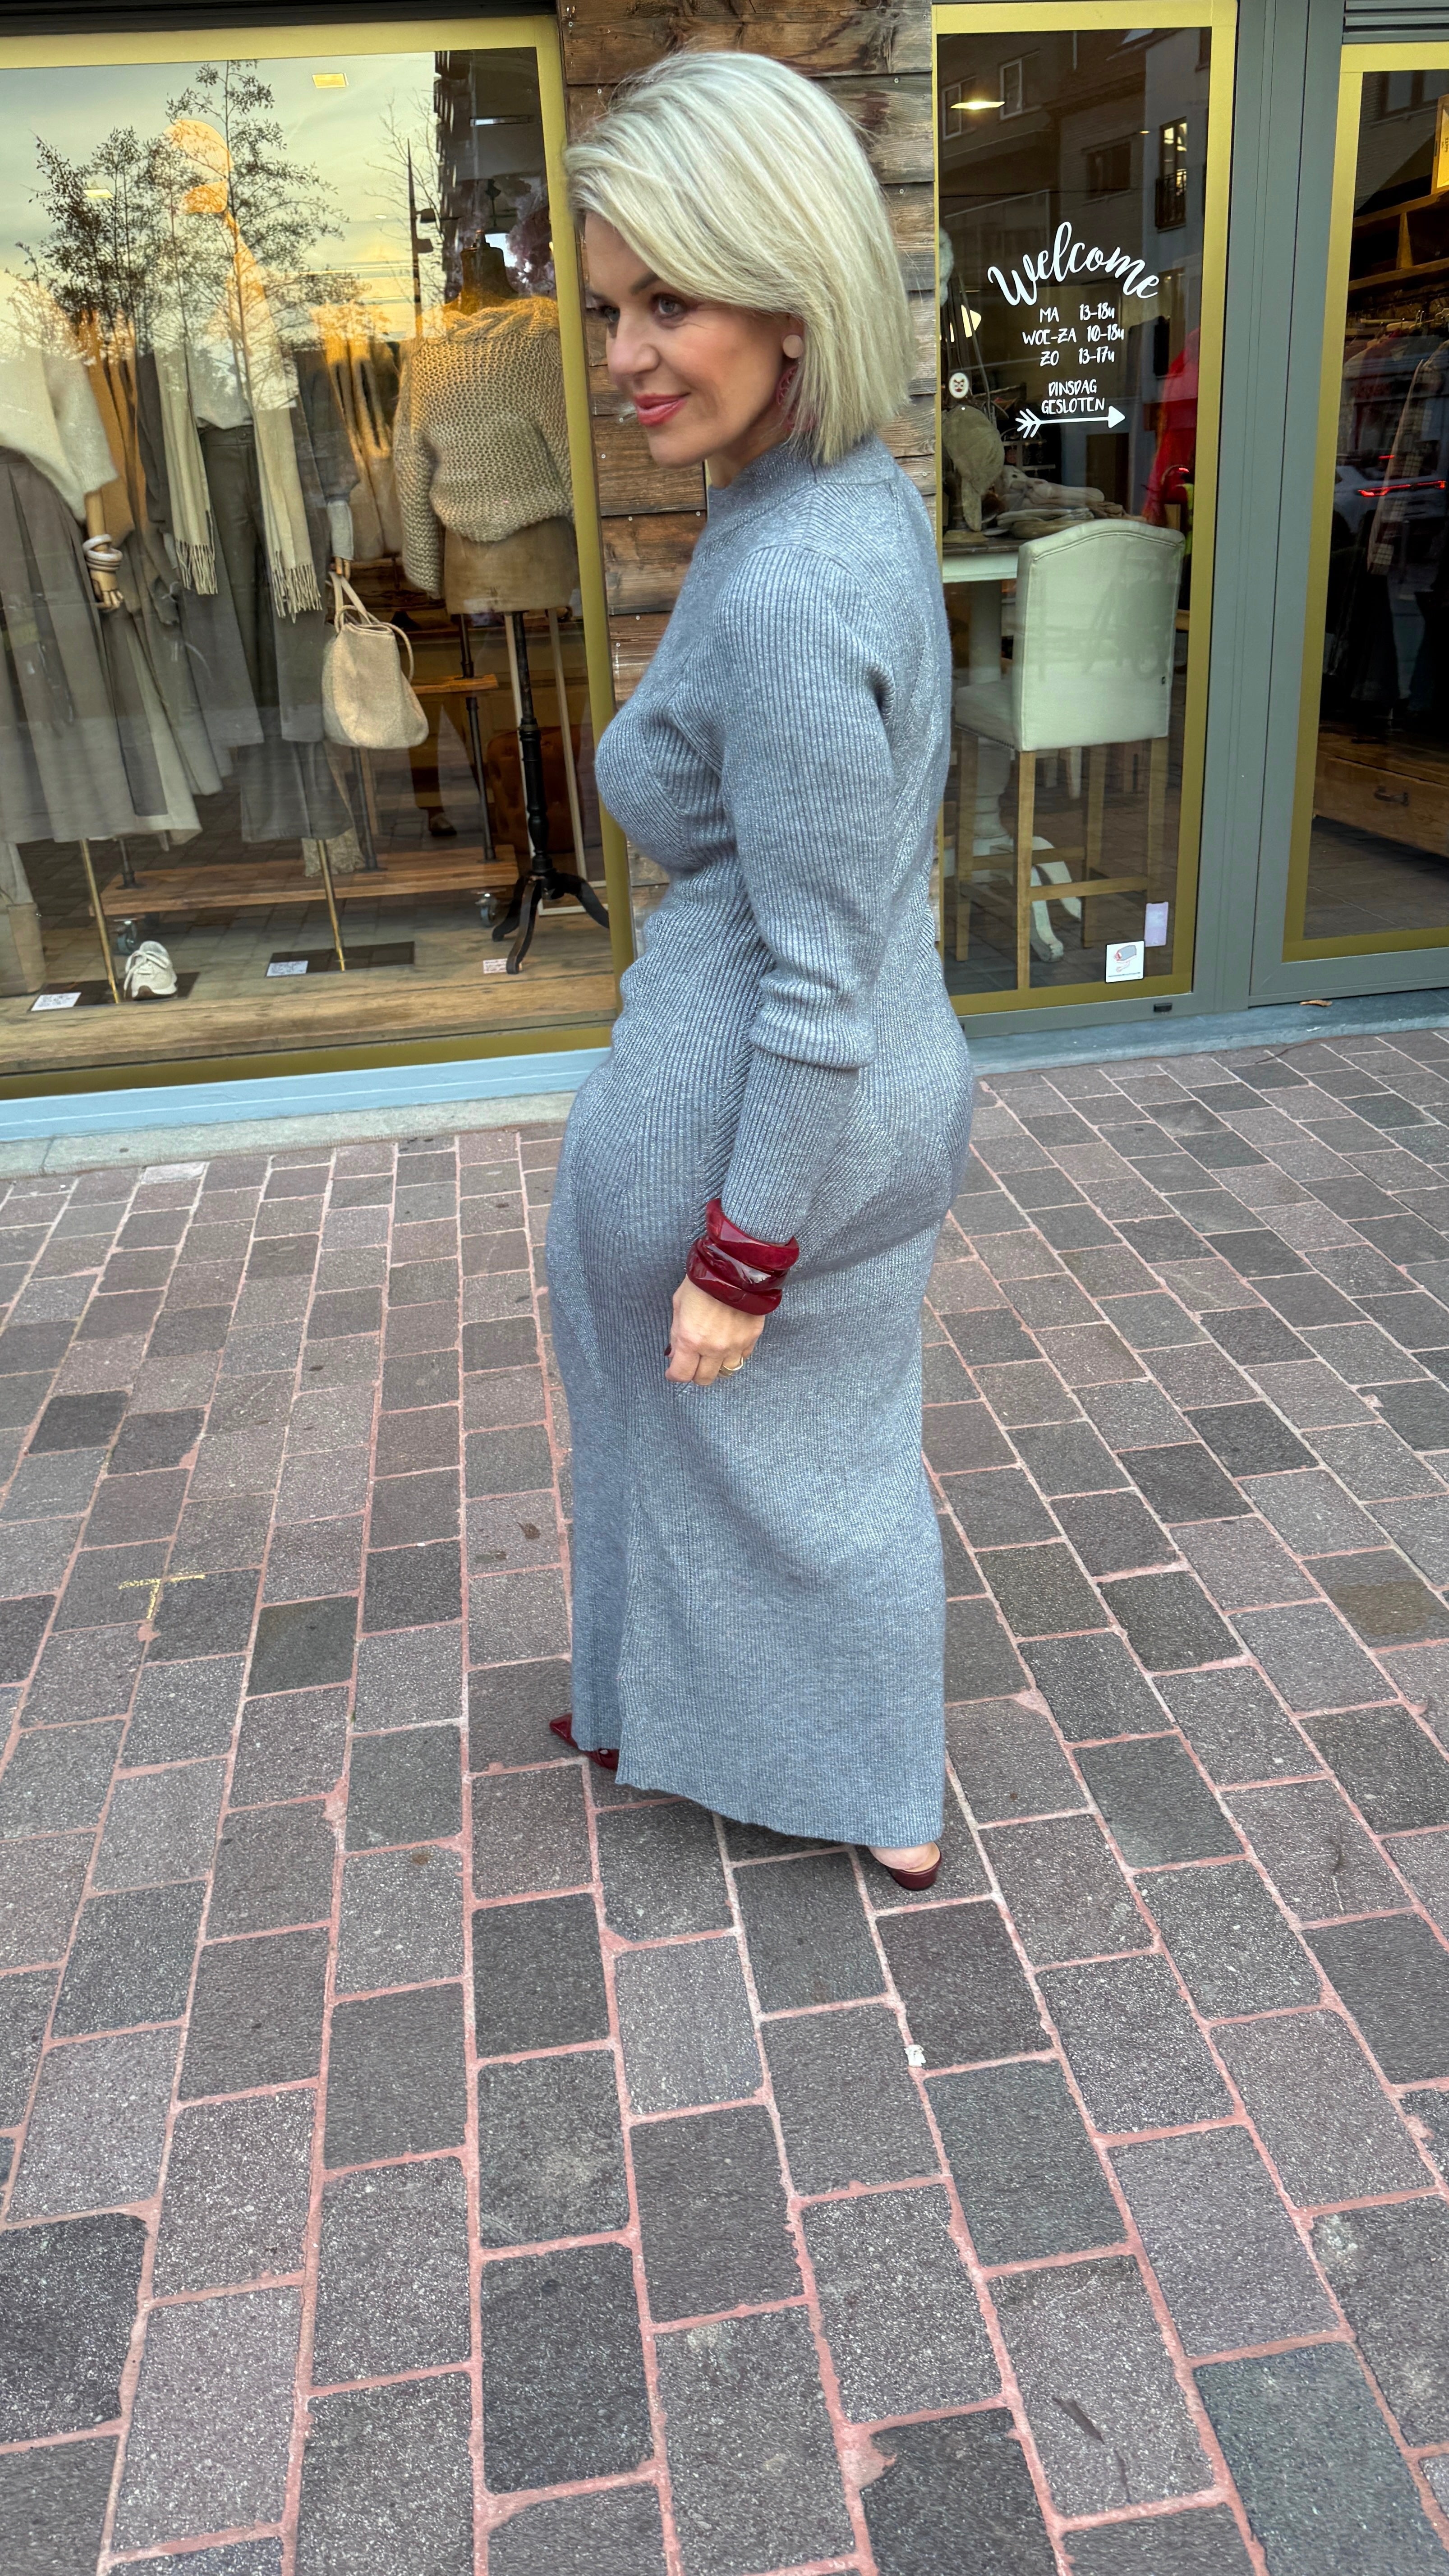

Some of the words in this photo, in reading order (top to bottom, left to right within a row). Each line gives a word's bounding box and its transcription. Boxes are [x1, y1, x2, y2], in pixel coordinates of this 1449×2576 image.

[987, 221, 1159, 306] Welcome
[1040, 307, 1059, 323] MA
[1079, 302, 1115, 321] 13-18u
[1087, 324, 1125, 342] 10-18u
[1040, 350, 1059, 367] ZO
[1078, 346, 1115, 364] 13-17u
[1048, 379, 1097, 397] DINSDAG
[1041, 397, 1105, 414] GESLOTEN
